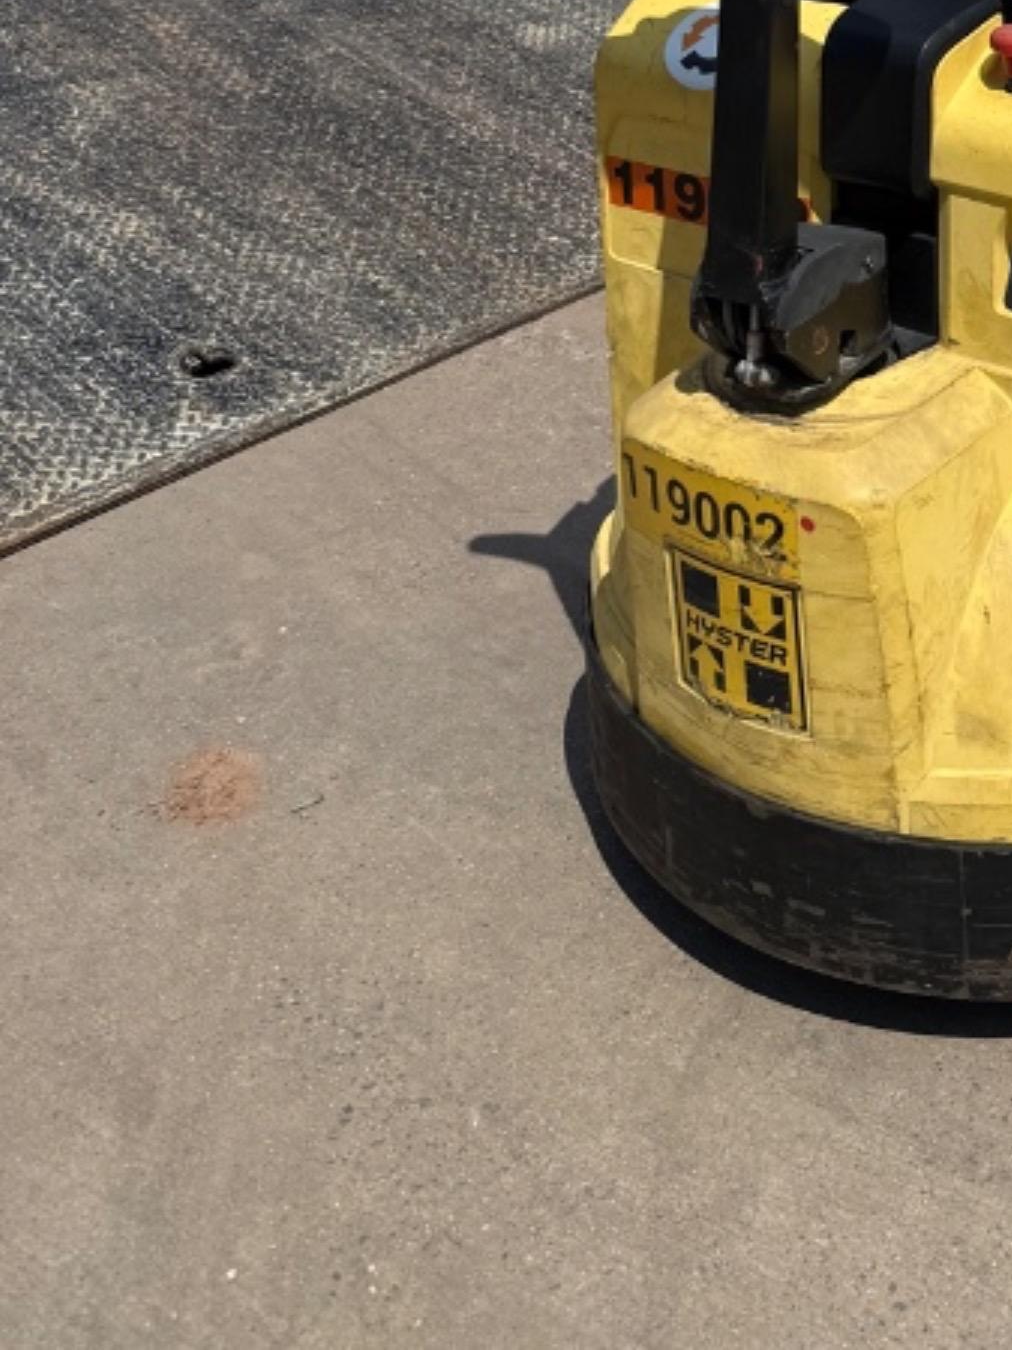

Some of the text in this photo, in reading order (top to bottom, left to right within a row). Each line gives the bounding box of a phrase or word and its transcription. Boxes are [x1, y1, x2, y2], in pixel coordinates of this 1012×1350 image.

[613, 157, 707, 222] 119
[623, 452, 787, 562] 119002
[686, 608, 787, 667] HYSTER
